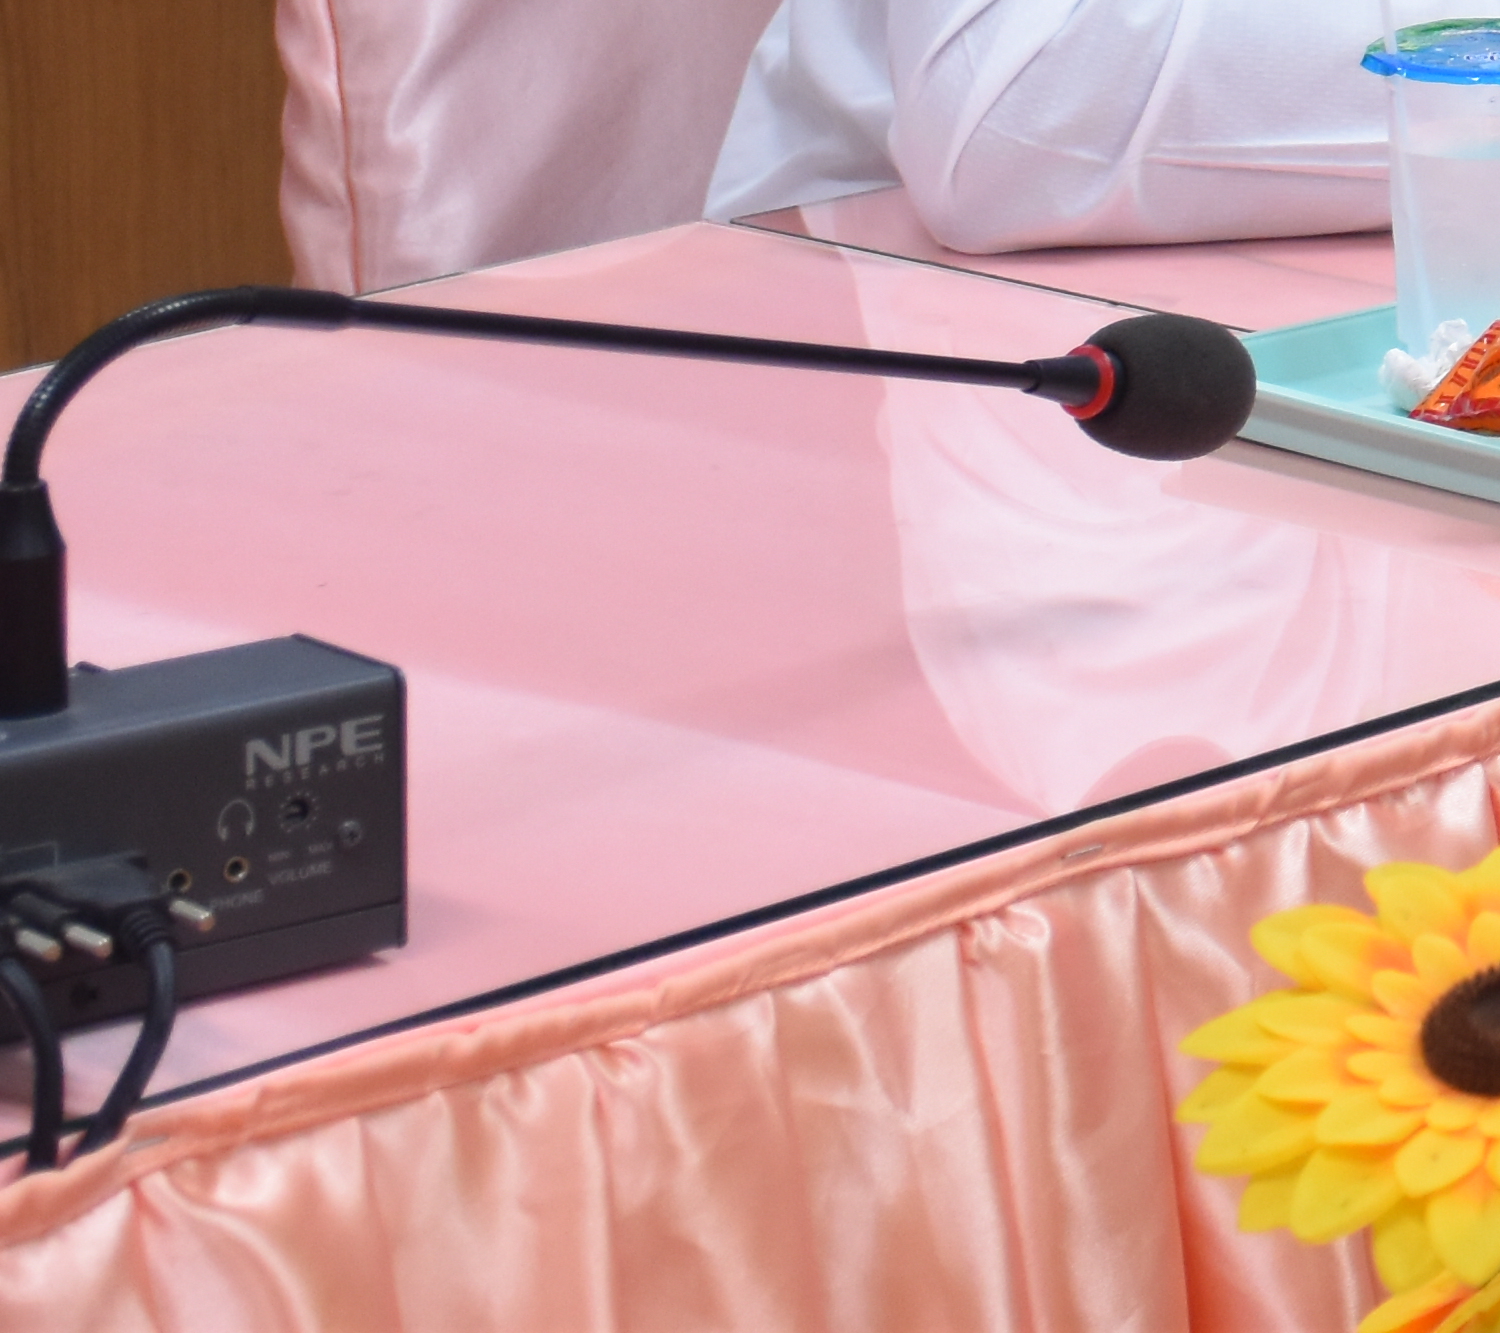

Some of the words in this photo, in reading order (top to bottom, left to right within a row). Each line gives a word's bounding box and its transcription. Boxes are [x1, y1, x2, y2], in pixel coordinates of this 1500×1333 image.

[245, 714, 385, 777] NPE
[246, 752, 385, 790] RESEARCH
[268, 860, 333, 886] VOLUME
